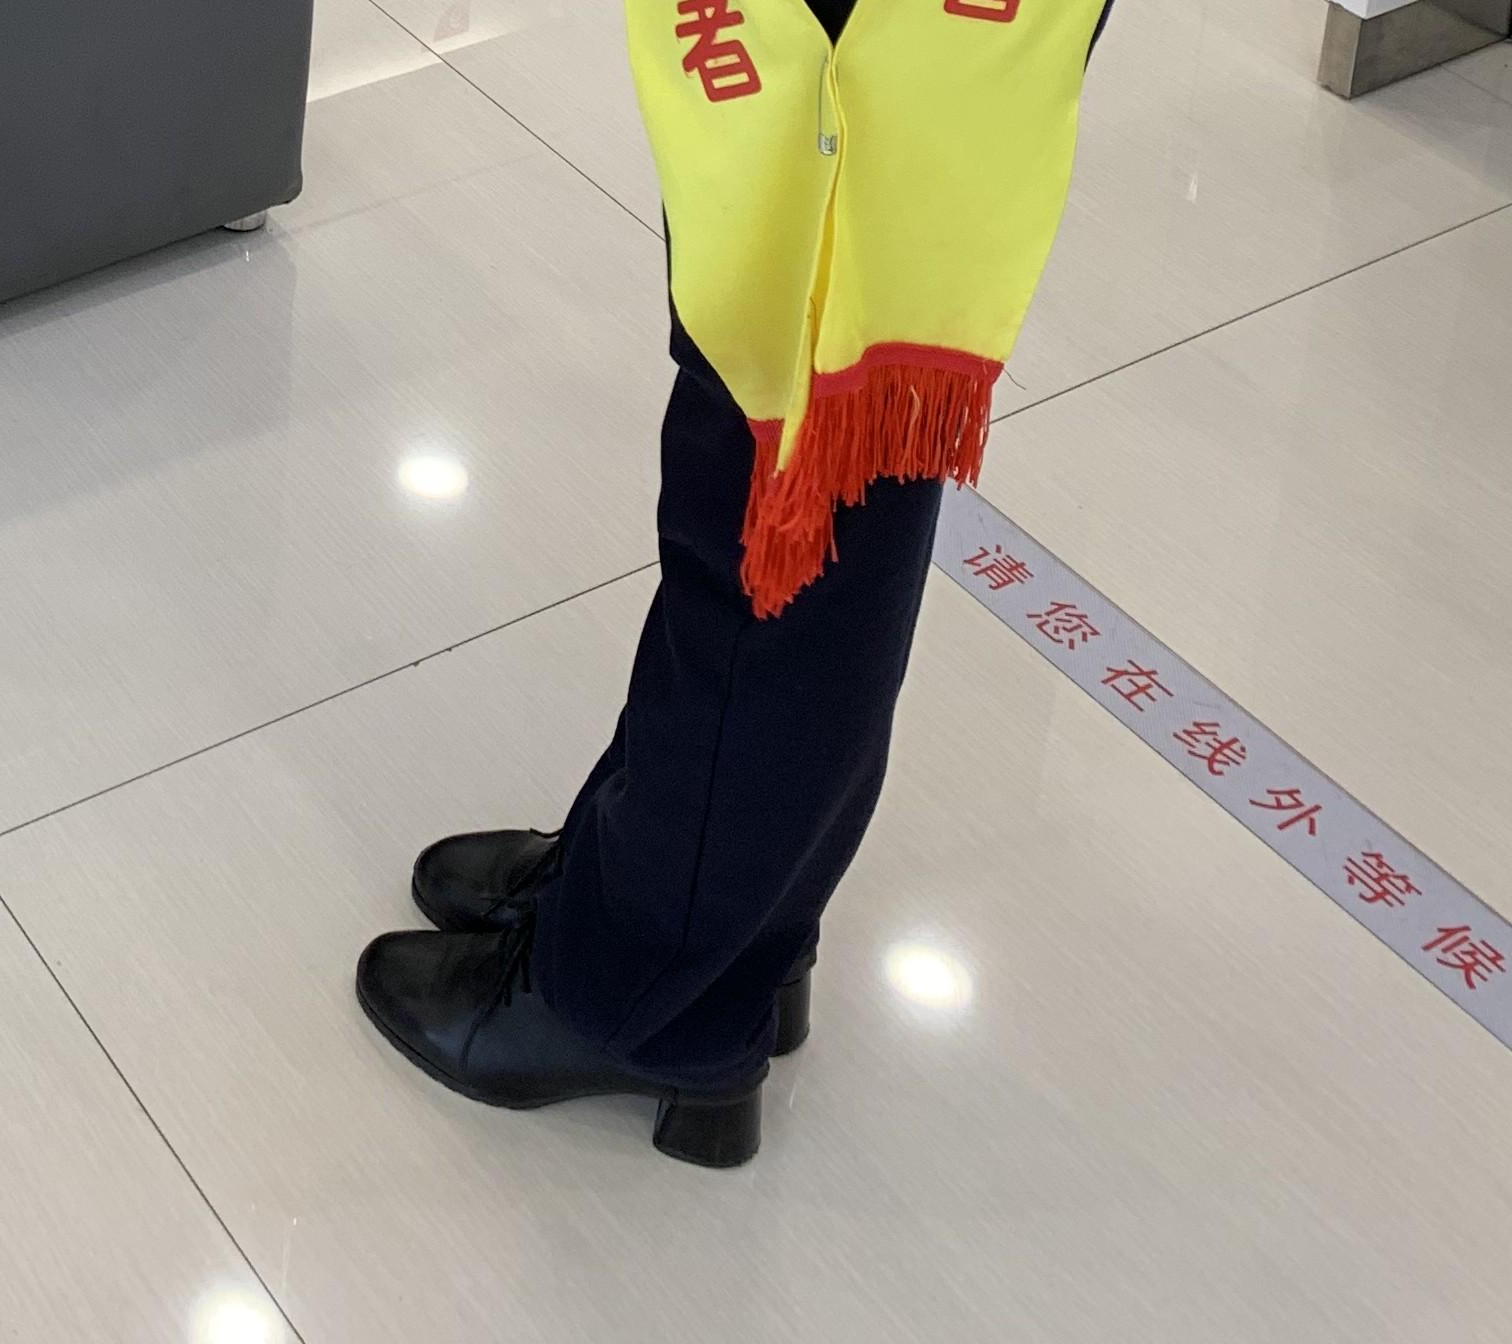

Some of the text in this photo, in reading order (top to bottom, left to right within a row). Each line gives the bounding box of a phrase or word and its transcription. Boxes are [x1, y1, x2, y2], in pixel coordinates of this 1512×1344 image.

[962, 543, 1507, 991] 请您在线外等候
